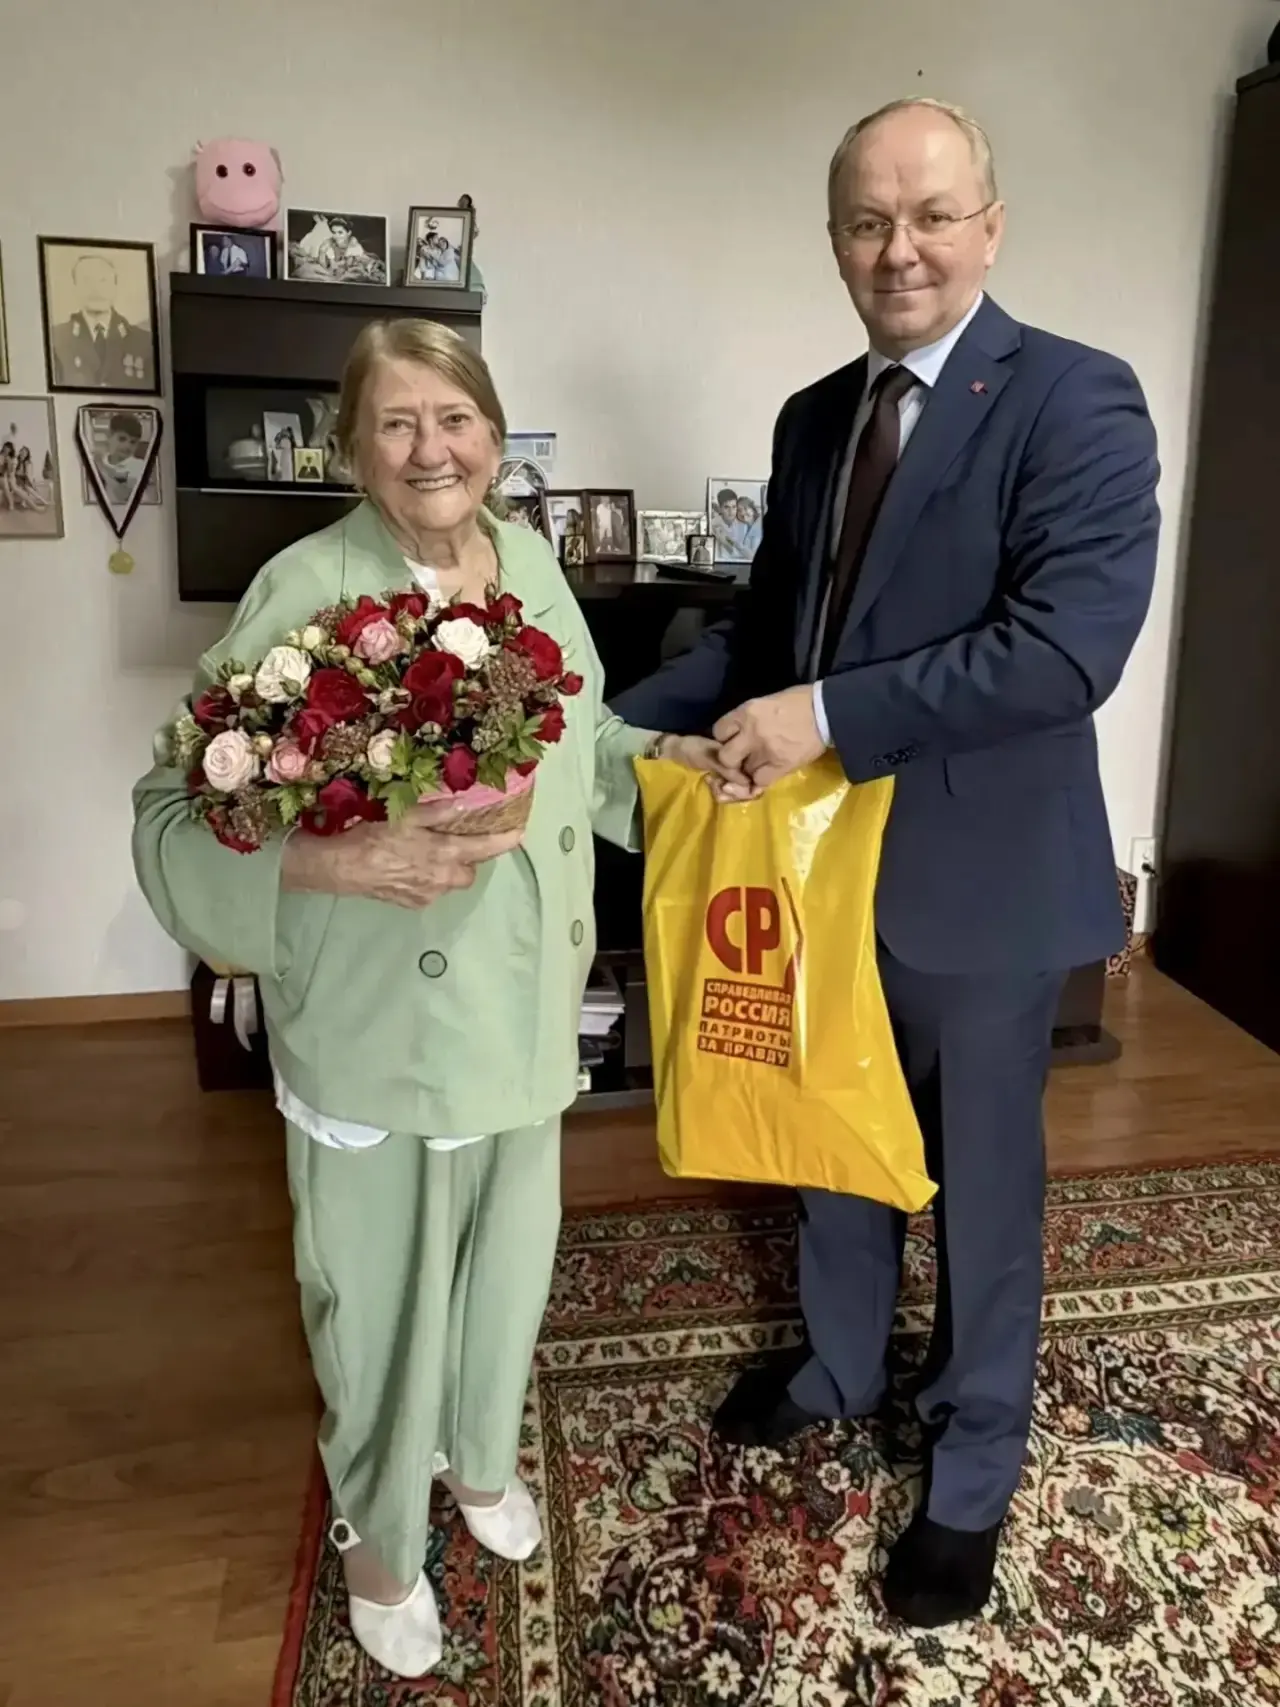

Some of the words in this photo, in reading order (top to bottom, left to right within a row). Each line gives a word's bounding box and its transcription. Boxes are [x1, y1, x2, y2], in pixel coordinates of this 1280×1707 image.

[704, 995, 791, 1028] РОССИЯ
[699, 1020, 792, 1049] ПАТРИОТЫ
[699, 1037, 718, 1052] ЗА
[723, 1041, 787, 1066] ПРАВДУ
